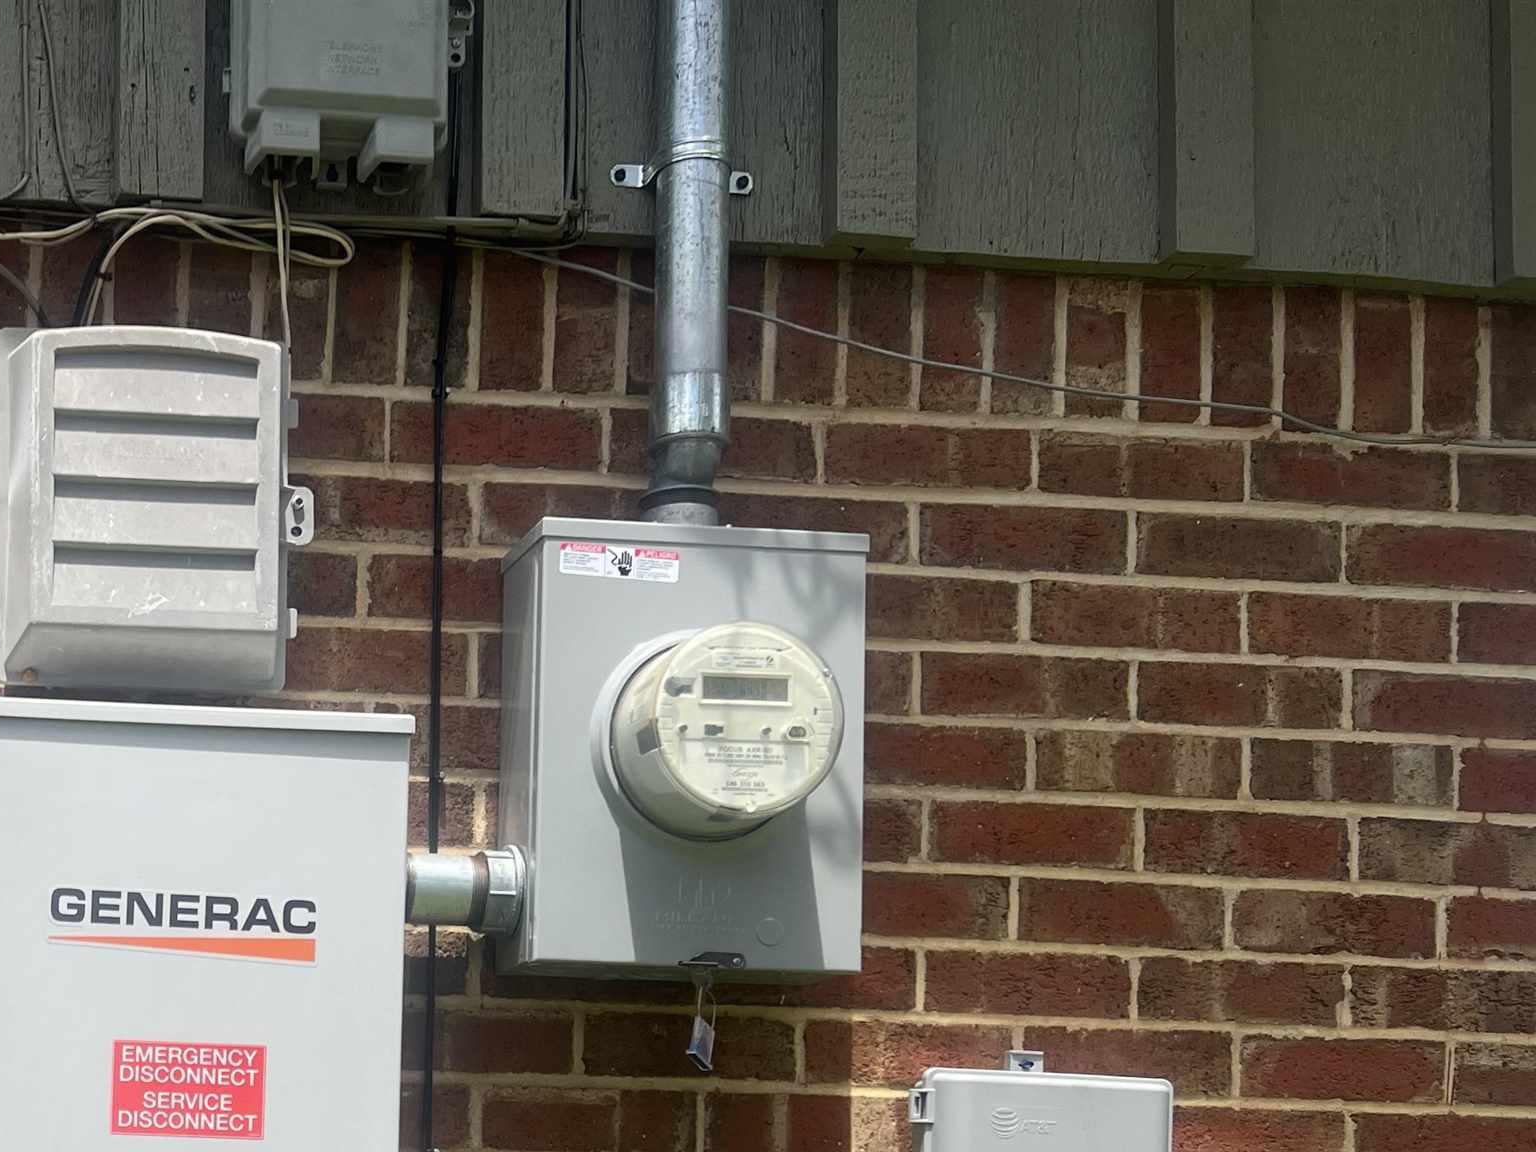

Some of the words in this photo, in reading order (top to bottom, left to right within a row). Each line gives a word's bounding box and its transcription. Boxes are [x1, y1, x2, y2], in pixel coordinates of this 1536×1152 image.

[50, 887, 316, 934] GENERAC
[121, 1045, 257, 1067] EMERGENCY
[119, 1065, 259, 1087] DISCONNECT
[143, 1091, 233, 1111] SERVICE
[117, 1110, 257, 1132] DISCONNECT
